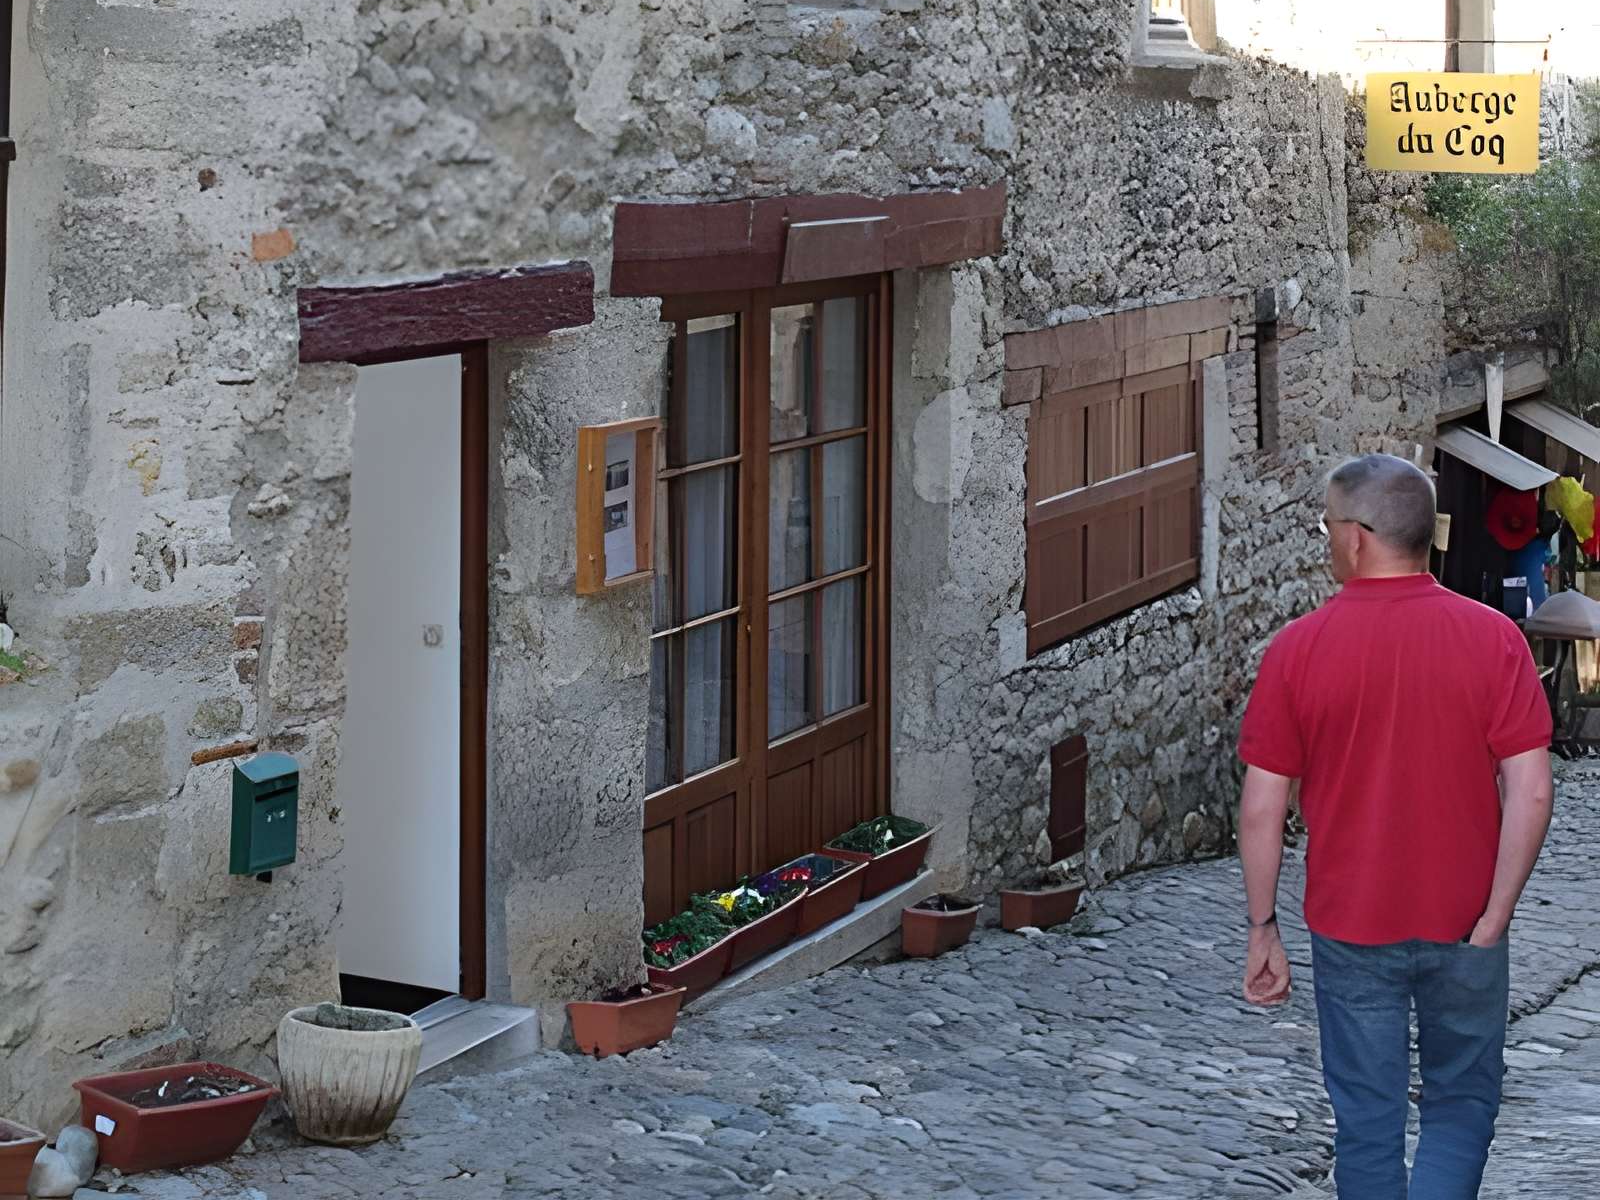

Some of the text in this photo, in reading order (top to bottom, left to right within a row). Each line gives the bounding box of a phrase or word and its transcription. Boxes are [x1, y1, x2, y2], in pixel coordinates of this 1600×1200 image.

[1390, 82, 1516, 123] Auberge
[1398, 122, 1505, 165] du Coq
